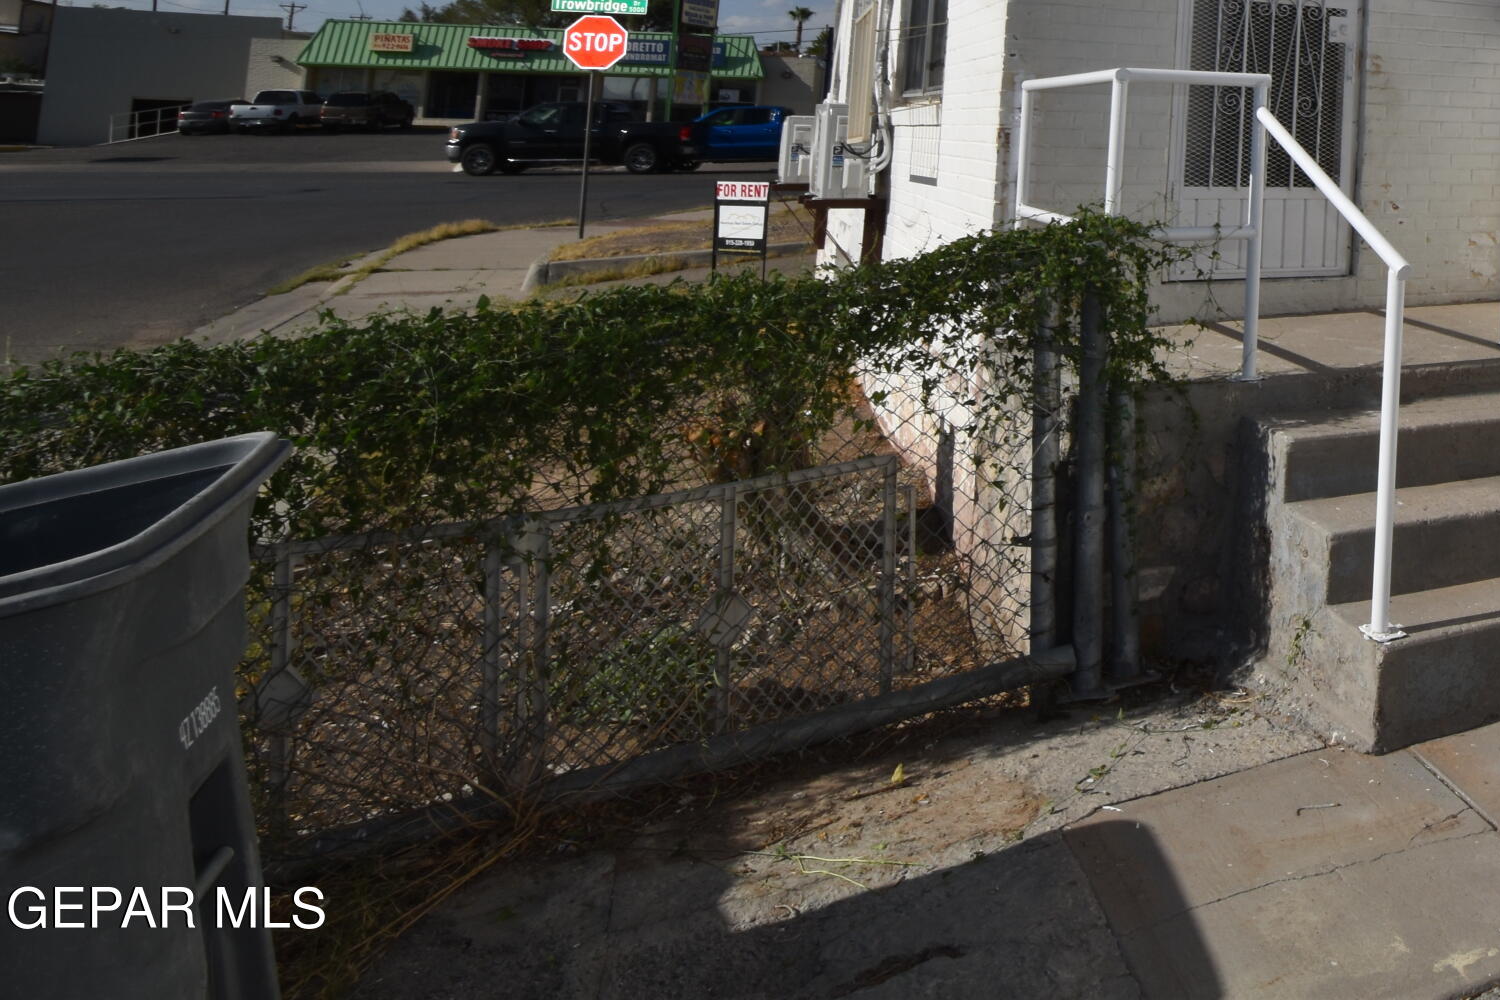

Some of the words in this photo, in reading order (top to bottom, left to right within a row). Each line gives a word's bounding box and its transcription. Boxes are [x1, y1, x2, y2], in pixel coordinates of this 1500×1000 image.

[568, 32, 623, 52] STOP
[627, 42, 664, 53] ORETTO
[716, 184, 737, 197] FOR
[741, 184, 768, 198] RENT
